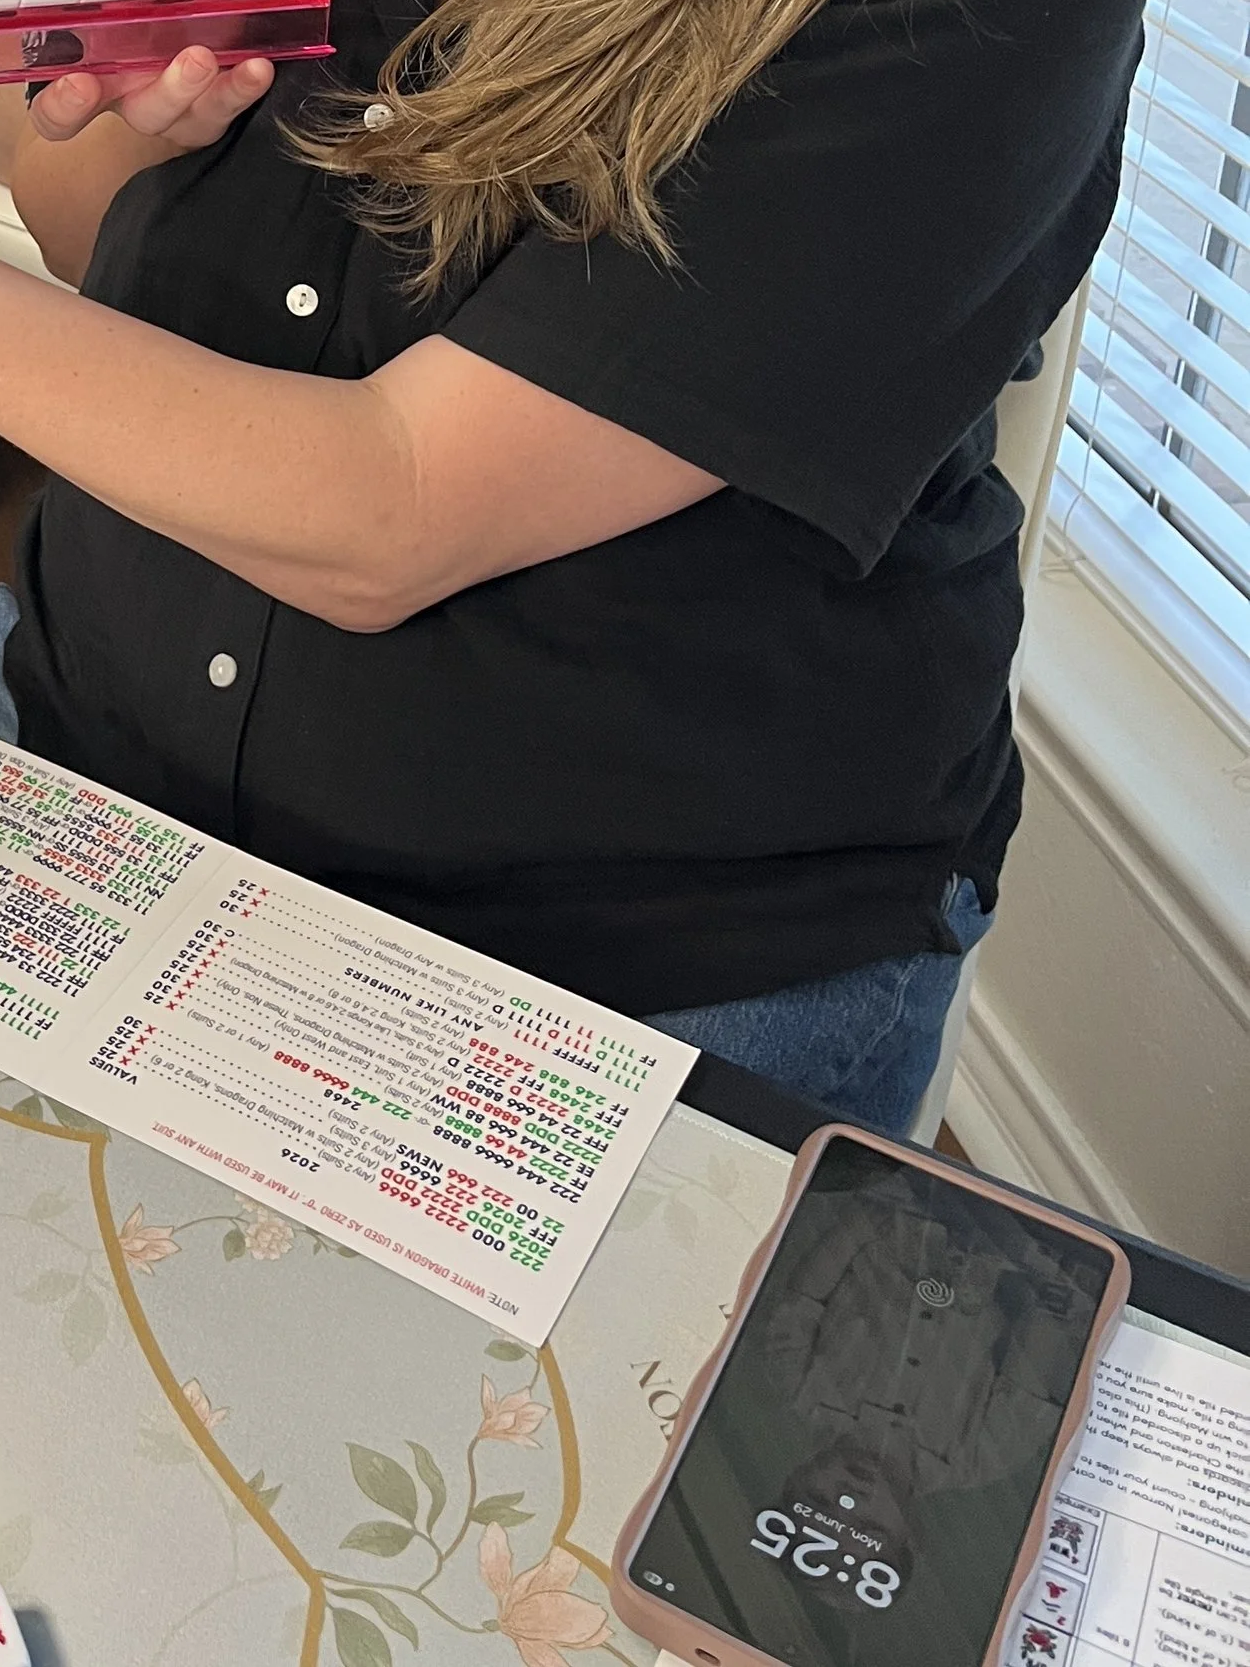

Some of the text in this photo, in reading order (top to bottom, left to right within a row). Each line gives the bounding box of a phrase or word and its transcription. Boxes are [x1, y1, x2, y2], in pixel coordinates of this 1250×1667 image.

[342, 966, 483, 1032] ANY LIKE NUMBERS
[96, 1045, 117, 1060] 25
[118, 1055, 131, 1065] X
[87, 1054, 139, 1085] VALUES
[322, 1087, 362, 1111] 2468
[173, 1132, 197, 1148] ANY
[196, 1143, 224, 1162] WITH
[222, 1156, 250, 1175] USED
[279, 1147, 320, 1172] 2026
[248, 1169, 265, 1182] BE
[263, 1176, 288, 1194] MAY
[287, 1189, 300, 1200] IT
[376, 1180, 421, 1208] 6666
[395, 1143, 564, 1234] 22 00 222 666 NEWS
[319, 1205, 347, 1225] ZERO
[379, 1166, 551, 1259] 2026 DDD 2222 DDD
[397, 1159, 557, 1246] FFF 2026 222 6666
[345, 1218, 363, 1232] AS
[423, 1203, 469, 1232] 2222
[362, 1226, 391, 1247] USED
[390, 1241, 404, 1254] IS
[470, 1227, 506, 1252] 000
[403, 1248, 450, 1277] DRAGON
[508, 1247, 544, 1272] 222
[449, 1272, 487, 1297] WHITE
[485, 1291, 520, 1315] NOTE:
[1095, 1400, 1221, 1453] up a discarded tile to
[1094, 1414, 1244, 1476] the Charleston and when
[1099, 1428, 1199, 1473] and always keep
[1079, 1455, 1186, 1501] count your tiles to
[794, 1503, 882, 1551] Mon, June 29
[750, 1510, 900, 1607] 8:25
